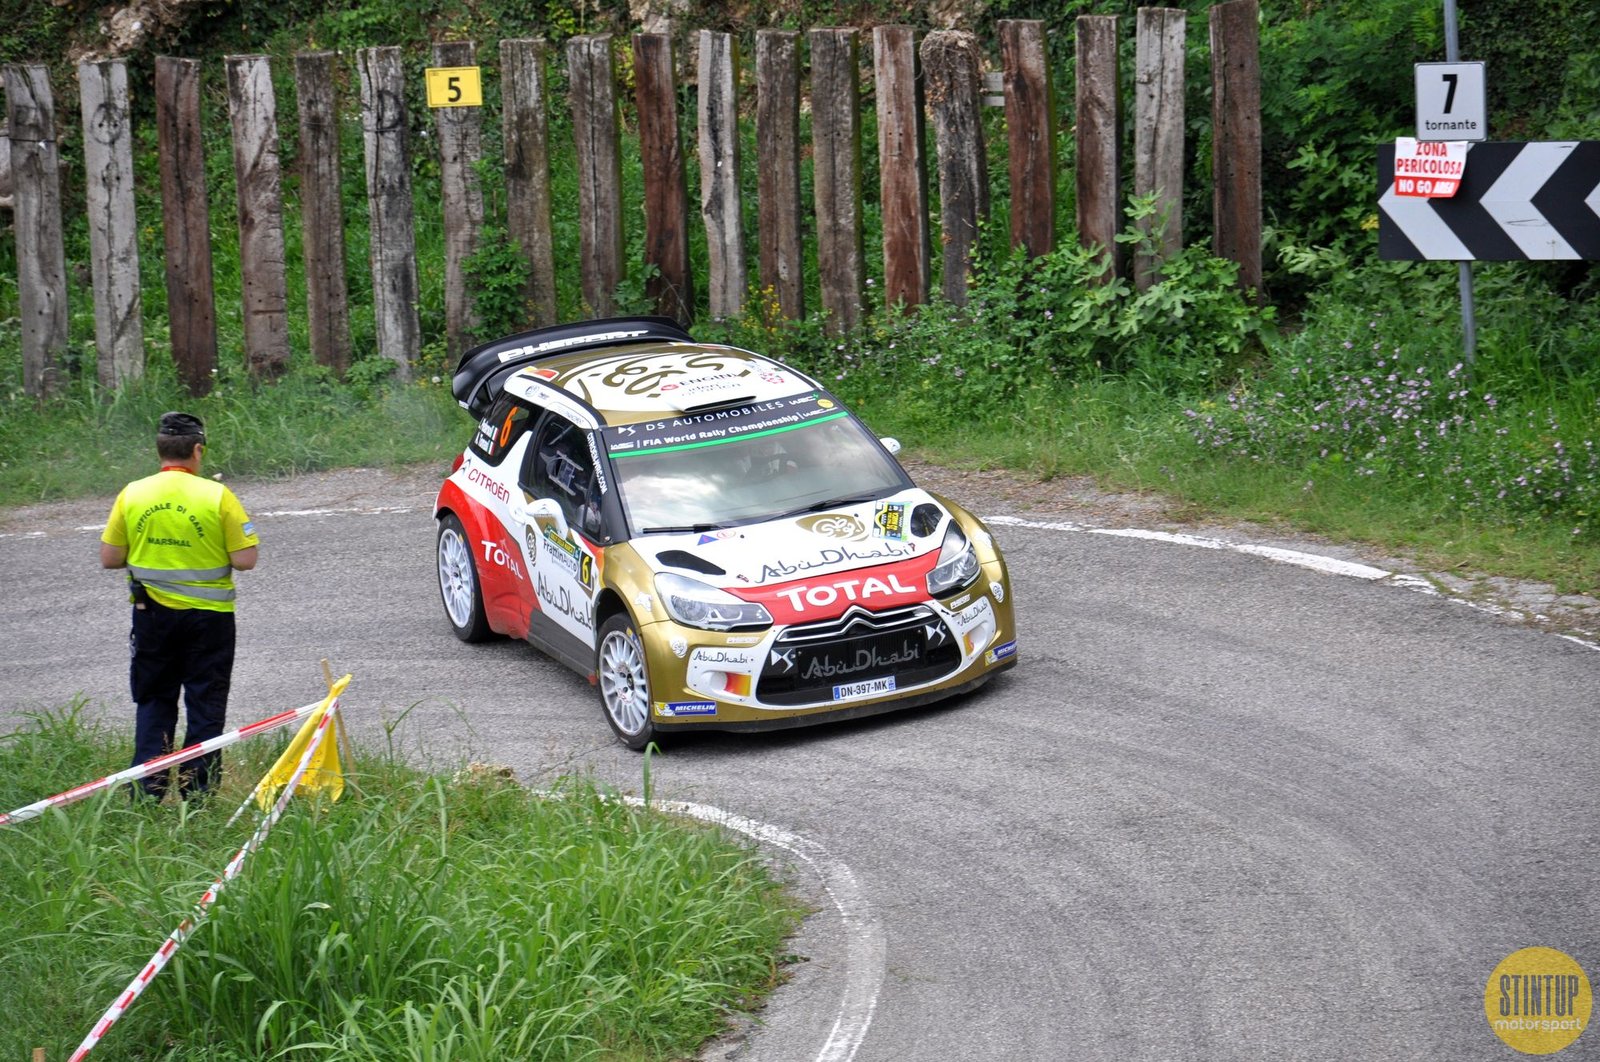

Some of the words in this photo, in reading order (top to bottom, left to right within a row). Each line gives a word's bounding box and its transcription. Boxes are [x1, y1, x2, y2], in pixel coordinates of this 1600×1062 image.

[447, 77, 462, 103] 5
[1442, 74, 1458, 114] 7
[1425, 119, 1477, 130] tornante
[1415, 142, 1448, 157] ZONA
[1396, 158, 1462, 175] PERICOLOSA
[1398, 179, 1414, 193] NO
[1416, 180, 1432, 194] GO
[500, 406, 519, 448] 6
[643, 439, 661, 447] FIA
[664, 433, 697, 444] World
[698, 428, 726, 438] Rally
[728, 413, 800, 434] Championship
[645, 421, 666, 432] DS
[673, 401, 785, 428] AUTOMOBILES
[137, 502, 171, 533] UFFICIALE
[177, 505, 187, 515] DI
[189, 515, 204, 539] GARA
[148, 537, 192, 548] MARSHAL
[481, 540, 524, 580] TOTAL
[582, 556, 590, 584] 6
[777, 574, 917, 612] TOTAL
[840, 680, 887, 697] DN-397-MK
[675, 704, 716, 712] MICHELIN
